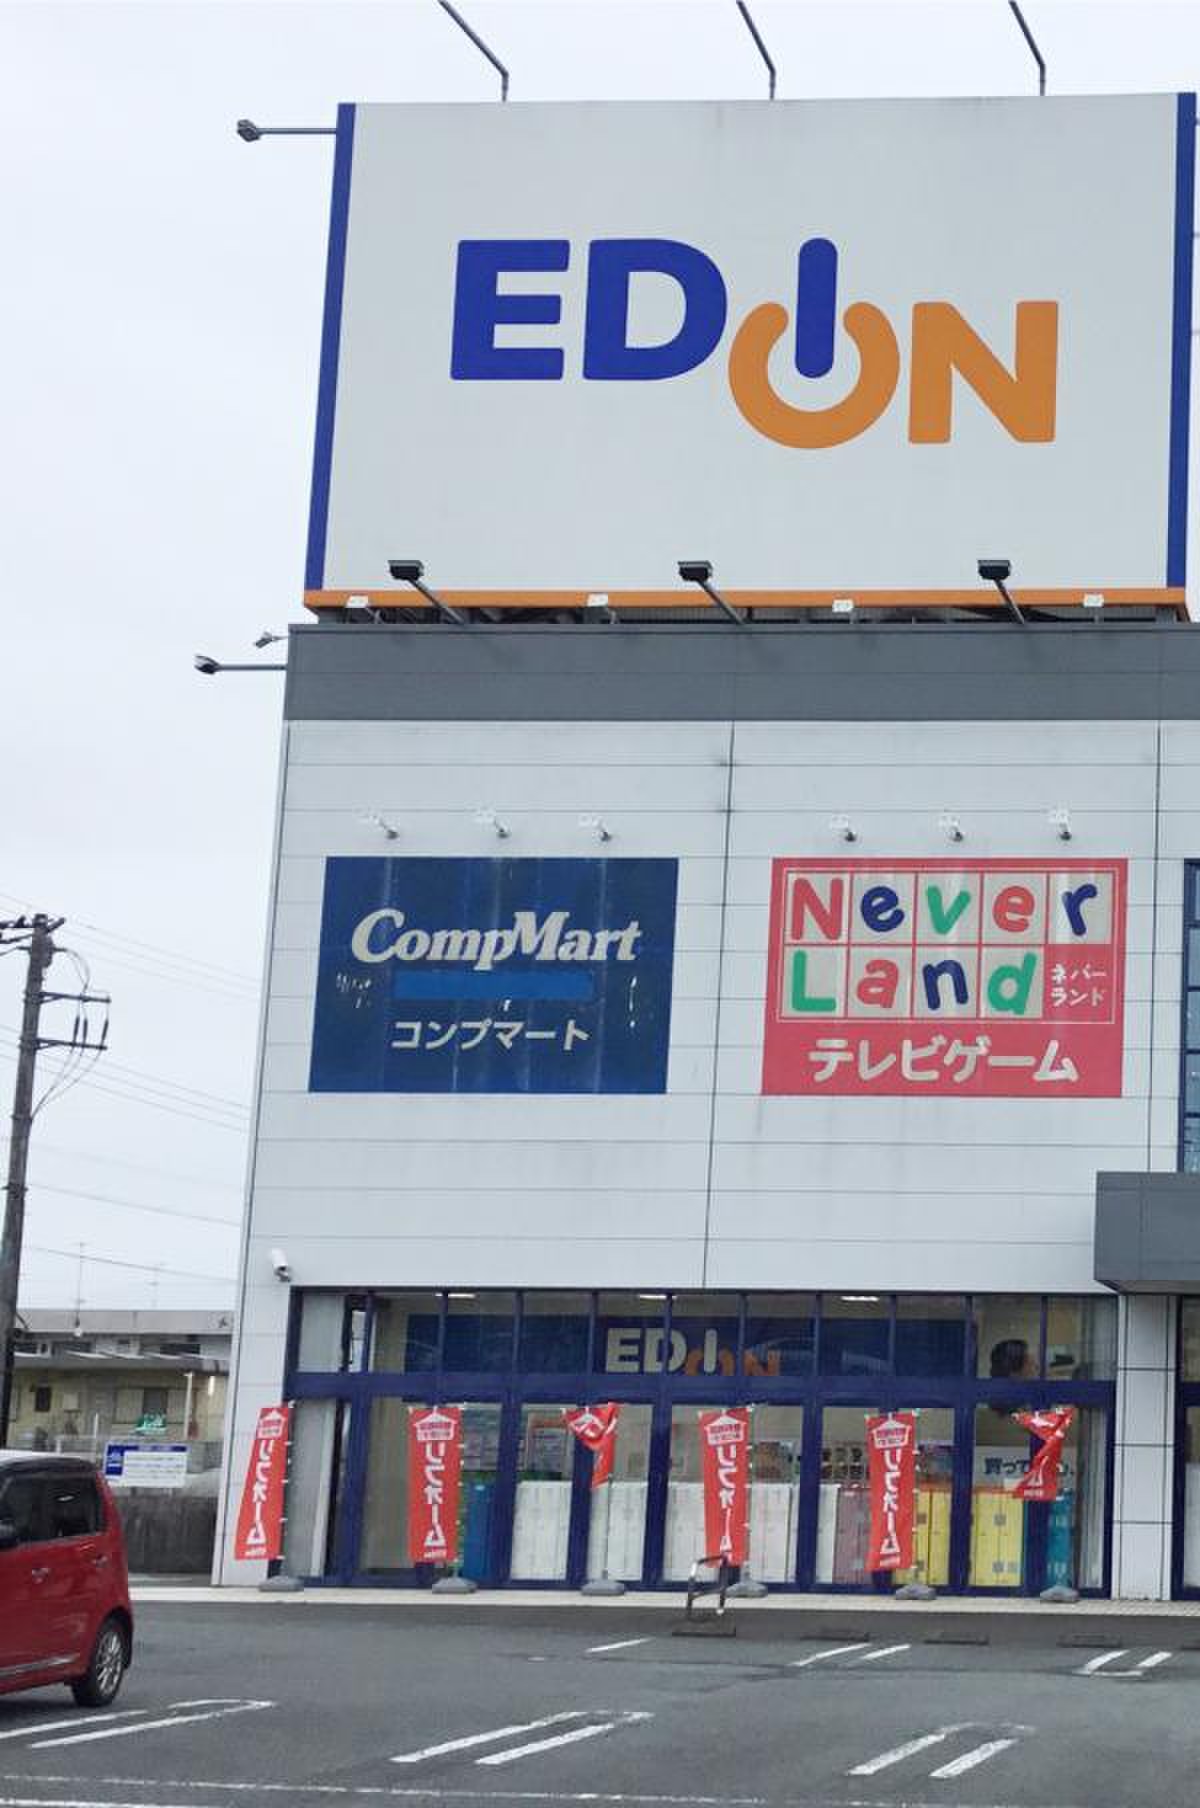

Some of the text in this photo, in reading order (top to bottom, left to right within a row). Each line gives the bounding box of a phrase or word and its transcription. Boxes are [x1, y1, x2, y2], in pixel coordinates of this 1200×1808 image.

[450, 237, 1059, 449] EDION
[790, 877, 1097, 940] Never
[351, 907, 642, 972] CompMart
[791, 949, 1038, 1015] Land
[1049, 963, 1107, 982] ネバー
[1049, 987, 1107, 1008] ランド
[391, 1018, 590, 1050] コンプマート
[808, 1034, 1079, 1083] テレビゲーム
